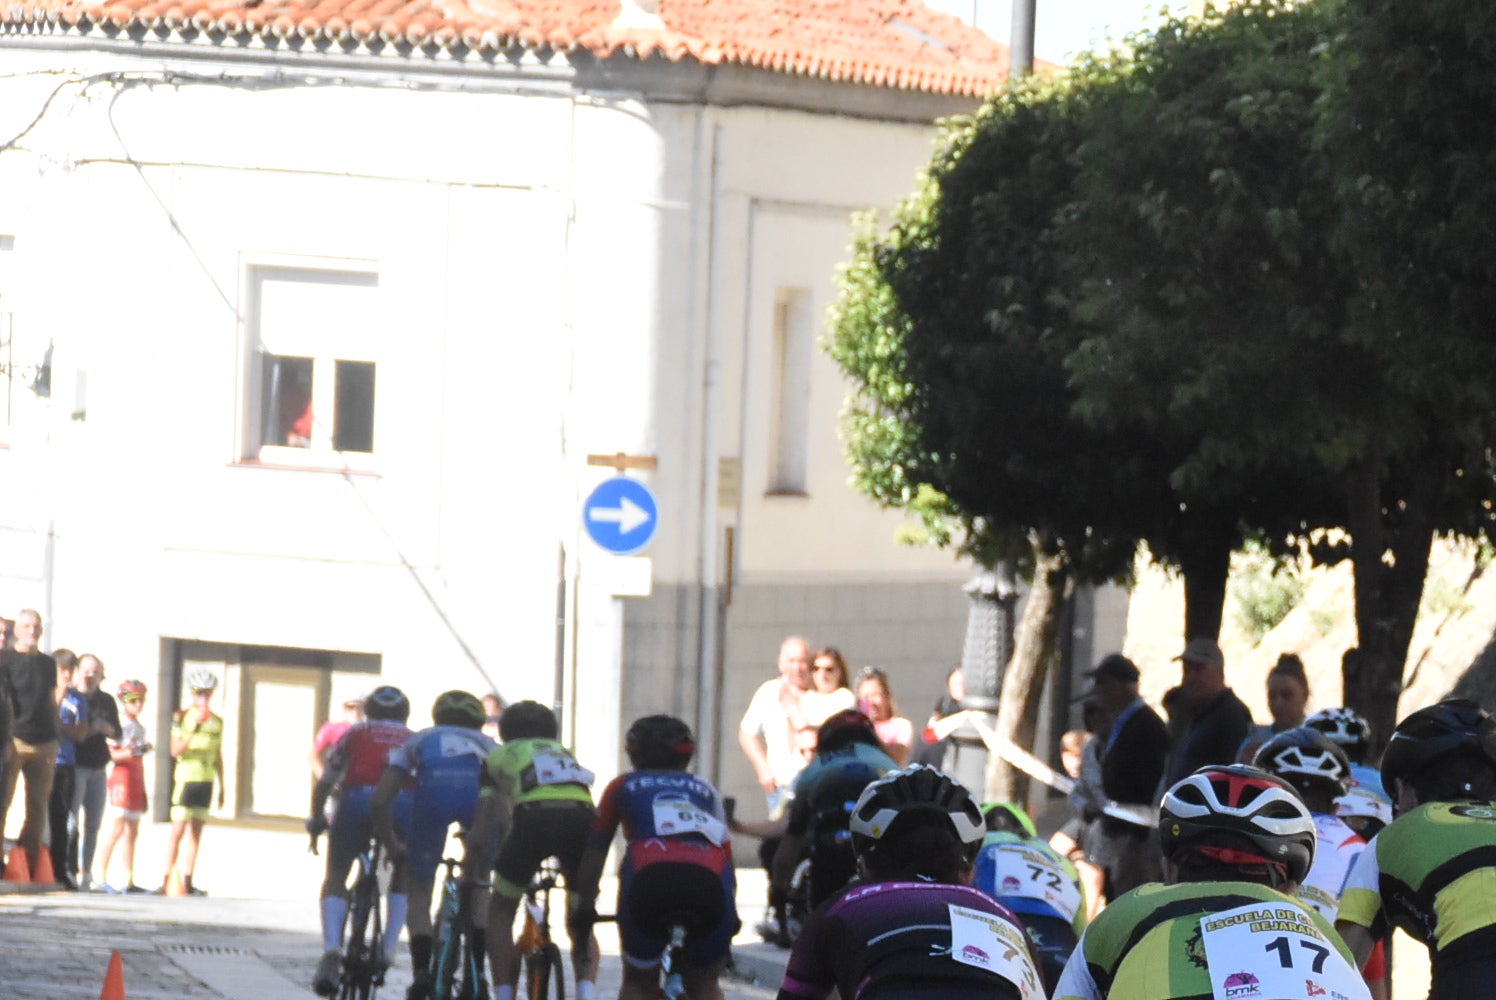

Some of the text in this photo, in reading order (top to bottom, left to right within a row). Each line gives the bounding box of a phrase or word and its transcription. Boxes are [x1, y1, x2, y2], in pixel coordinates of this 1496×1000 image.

[1027, 864, 1062, 892] 72
[1206, 909, 1273, 933] ESCUELA
[1276, 909, 1296, 922] DE
[1265, 936, 1330, 975] 17
[1226, 984, 1260, 998] bmk
